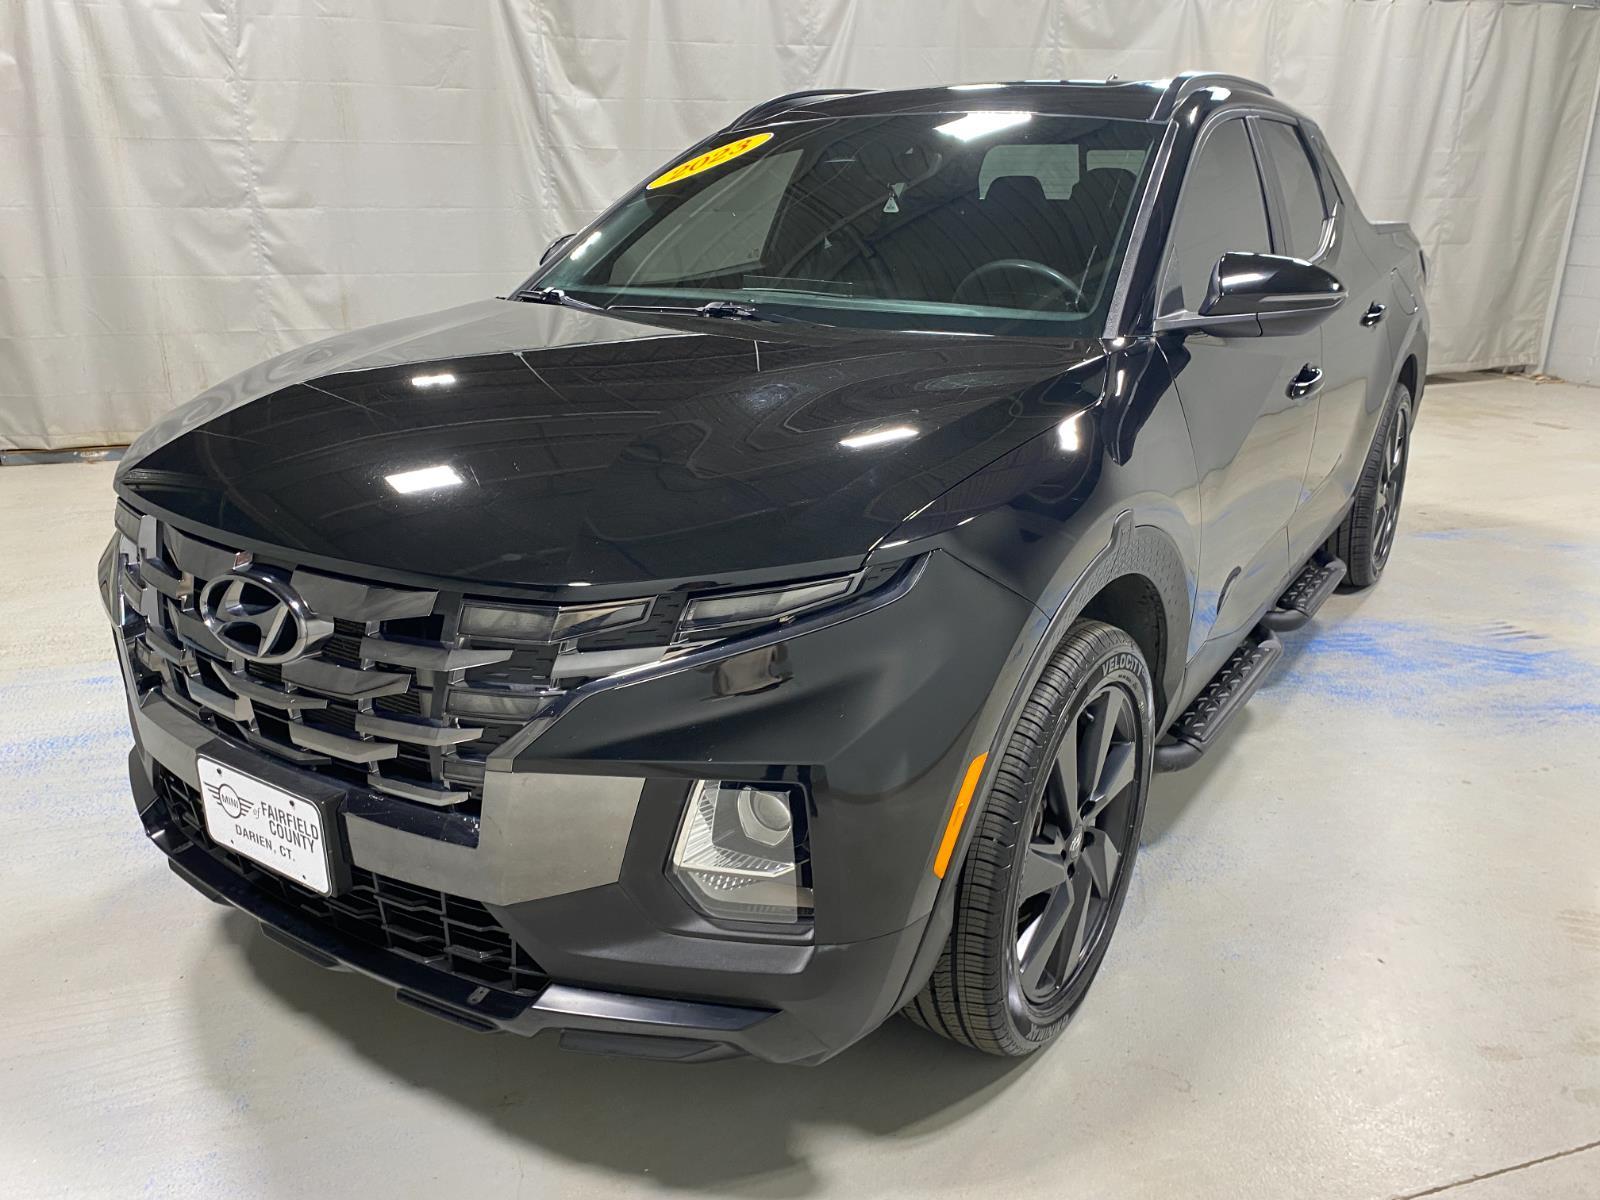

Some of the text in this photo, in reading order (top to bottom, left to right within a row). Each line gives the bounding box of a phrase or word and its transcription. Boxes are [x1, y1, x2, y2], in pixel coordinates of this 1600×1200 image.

[667, 139, 753, 181] 2023
[1102, 653, 1143, 677] VELOCITY
[221, 793, 239, 809] MINI
[253, 801, 319, 840] of FAIRFIELD
[269, 820, 314, 853] COUNTY
[279, 844, 296, 862] CT.
